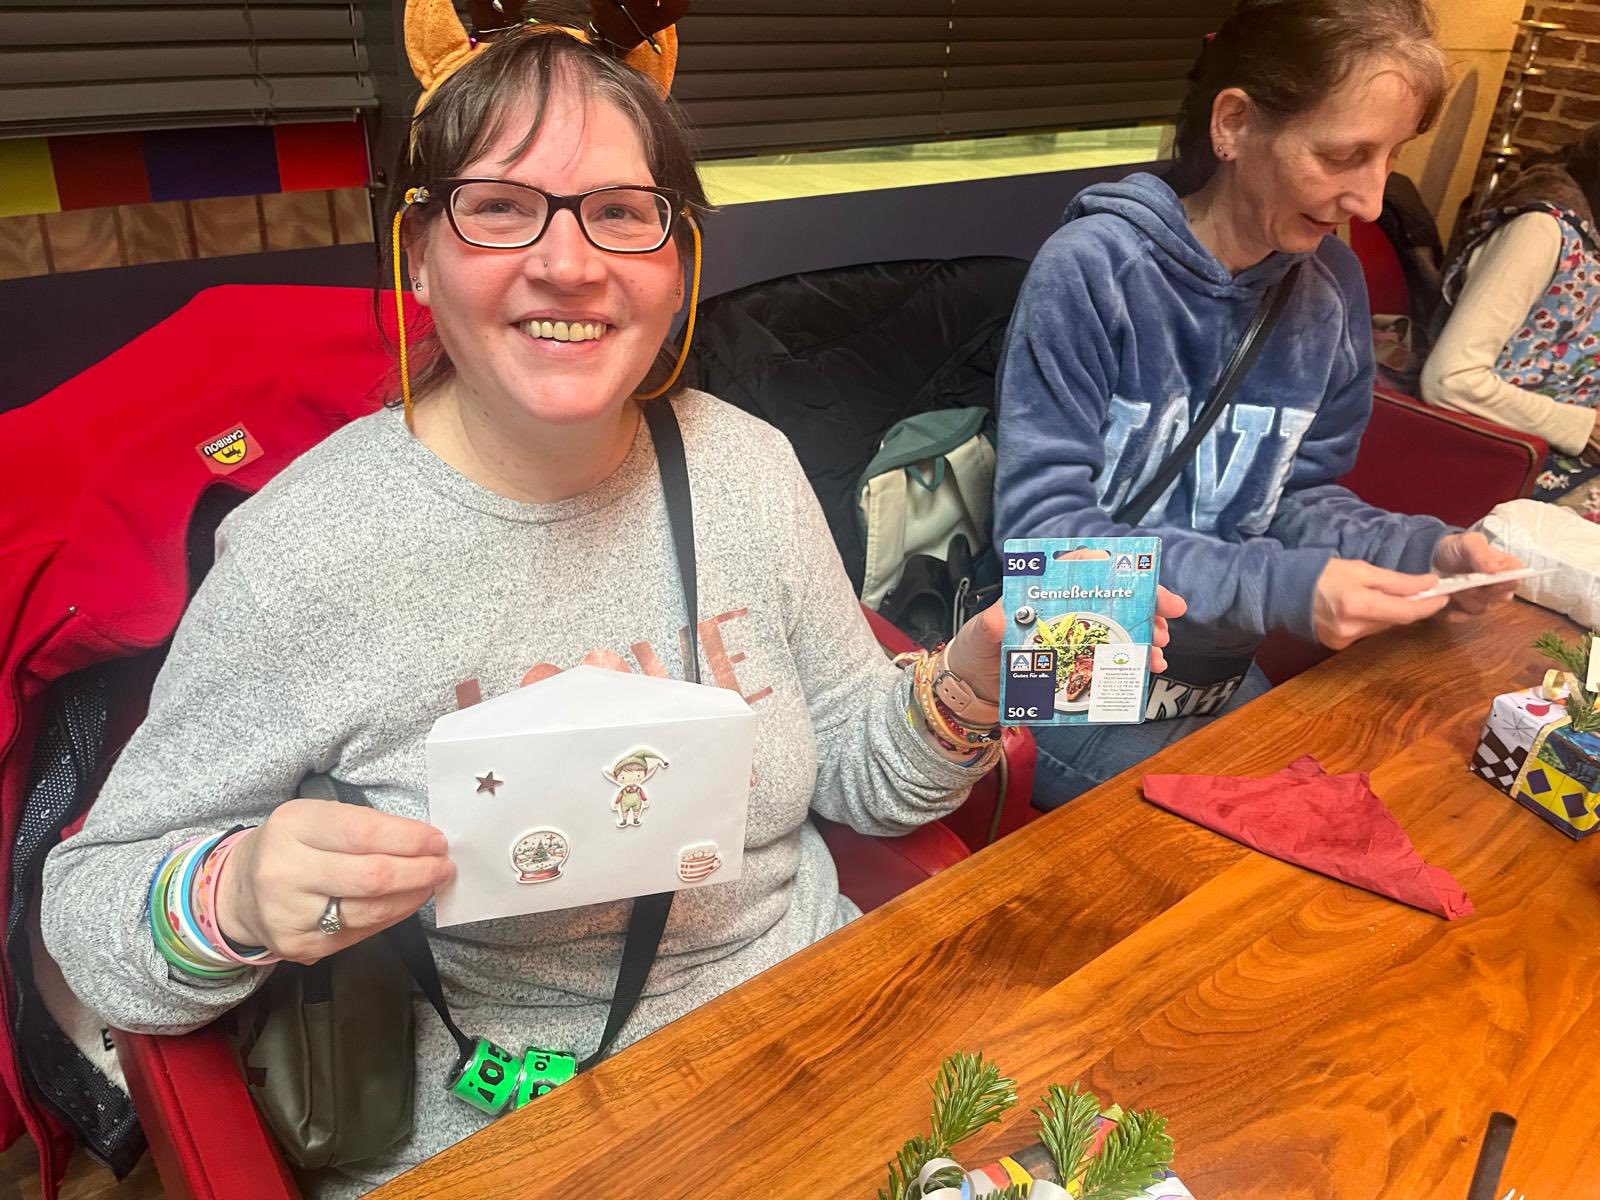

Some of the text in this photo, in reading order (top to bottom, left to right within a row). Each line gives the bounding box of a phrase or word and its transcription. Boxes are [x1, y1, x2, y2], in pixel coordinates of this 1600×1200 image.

[203, 429, 244, 456] CARIBOU
[1008, 557, 1041, 571] 50 €
[1027, 584, 1133, 600] Genießerkarte
[1008, 706, 1039, 718] 50 €
